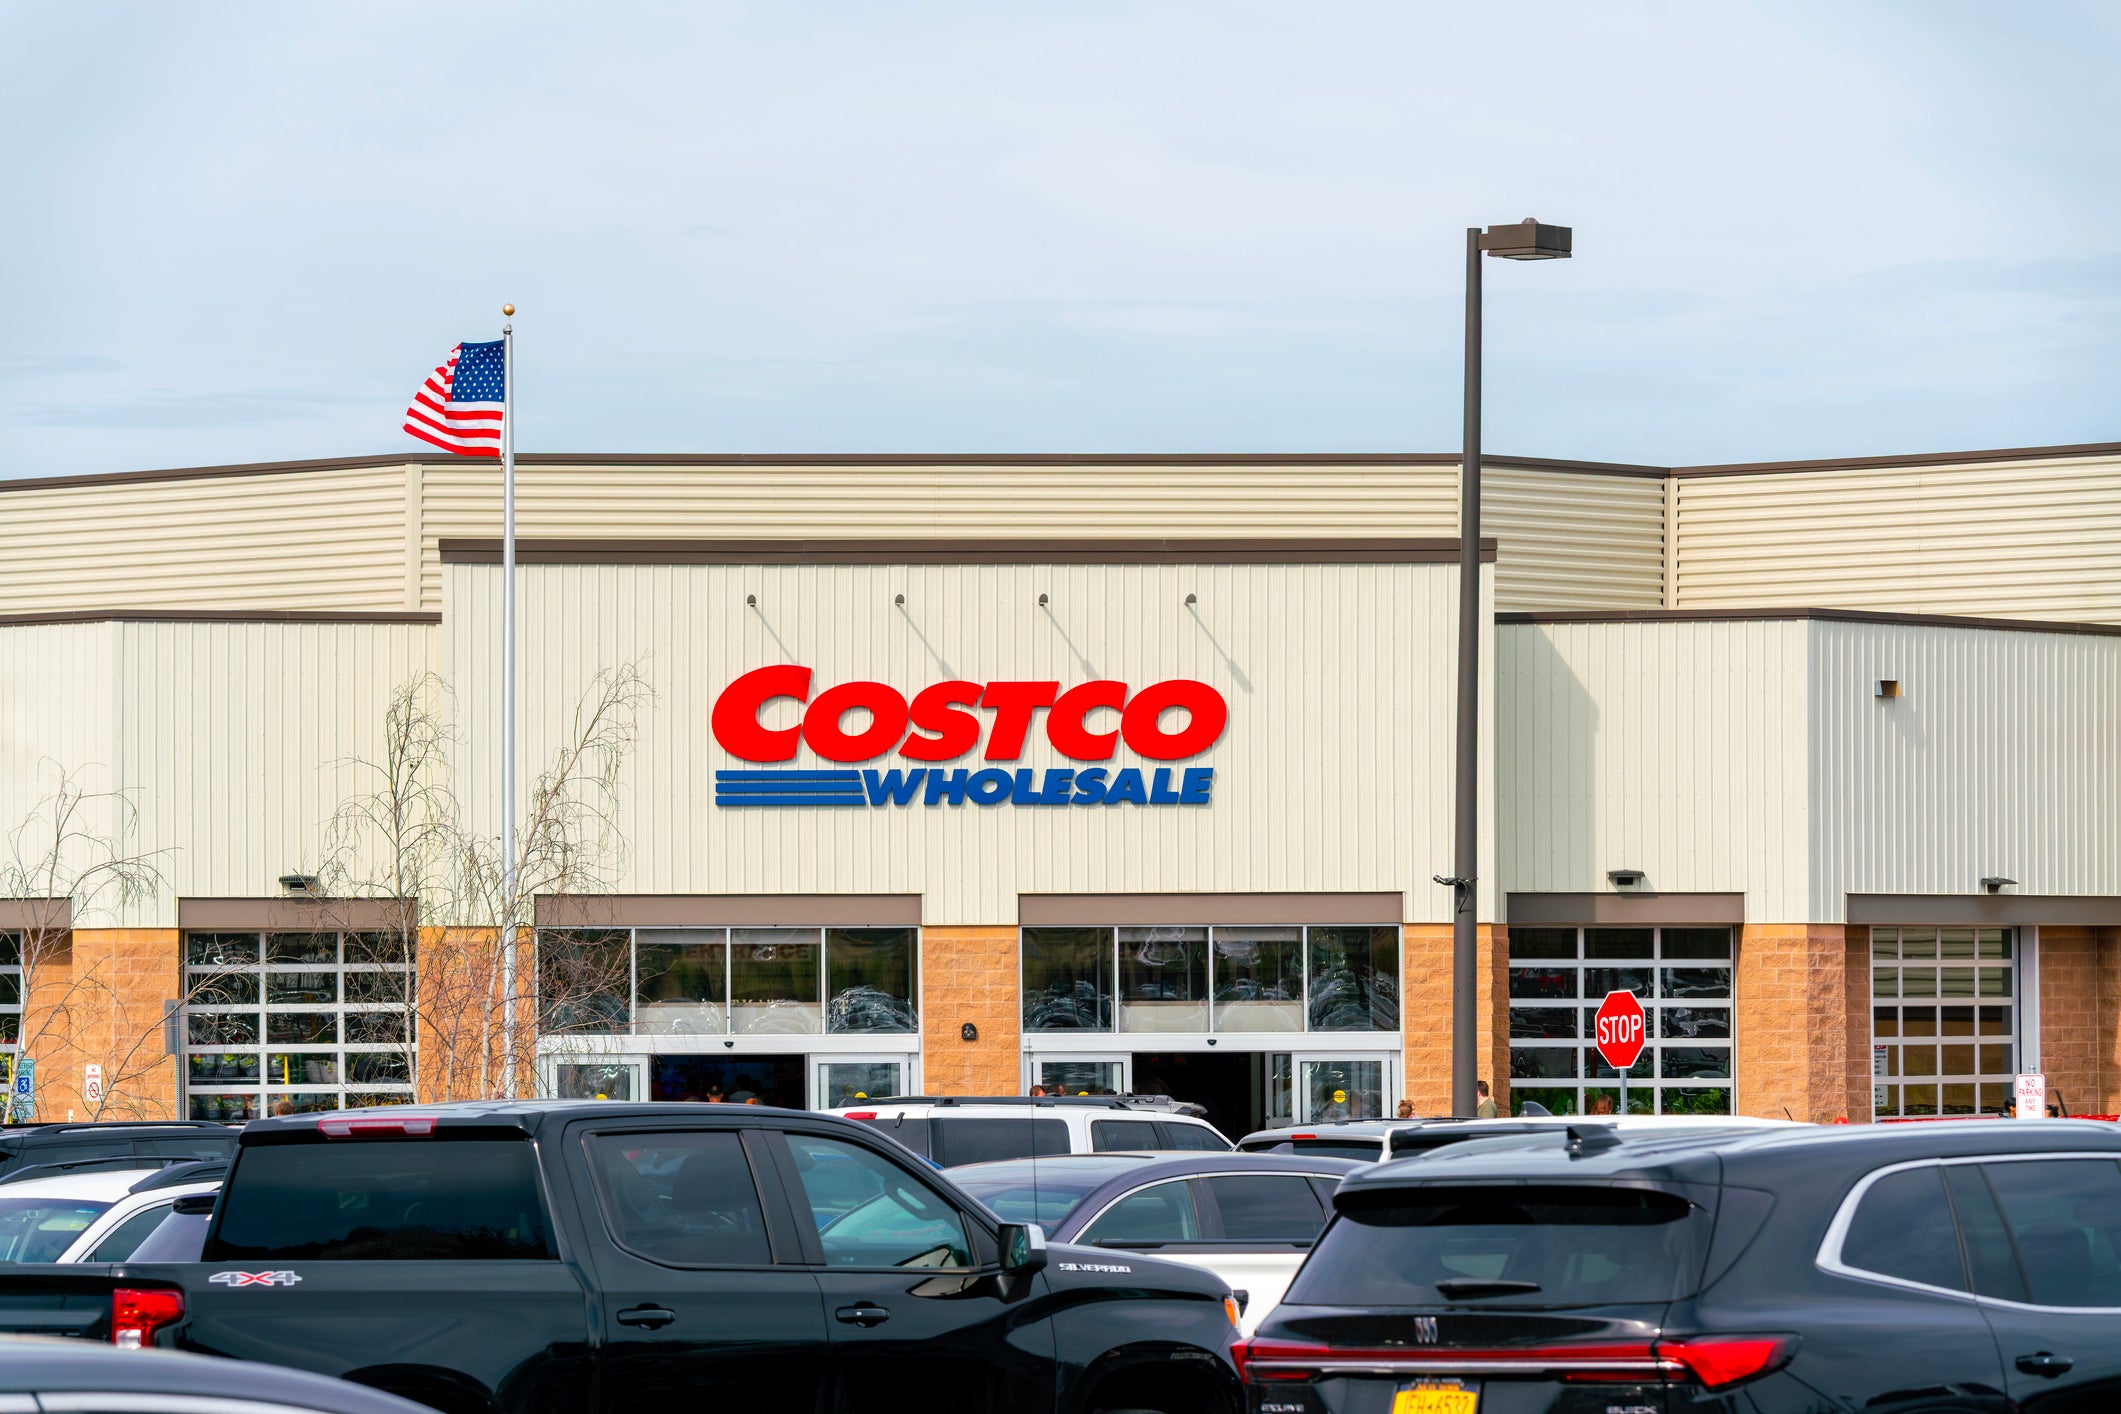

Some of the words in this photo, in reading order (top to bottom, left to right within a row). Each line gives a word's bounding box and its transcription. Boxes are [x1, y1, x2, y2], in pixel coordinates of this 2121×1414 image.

[711, 664, 1227, 762] COSTCO
[862, 767, 1213, 806] WHOLESALE
[1600, 1014, 1642, 1045] STOP
[2018, 1088, 2042, 1096] PARKING
[2025, 1078, 2036, 1087] NO
[1059, 1263, 1132, 1273] SILVERADO
